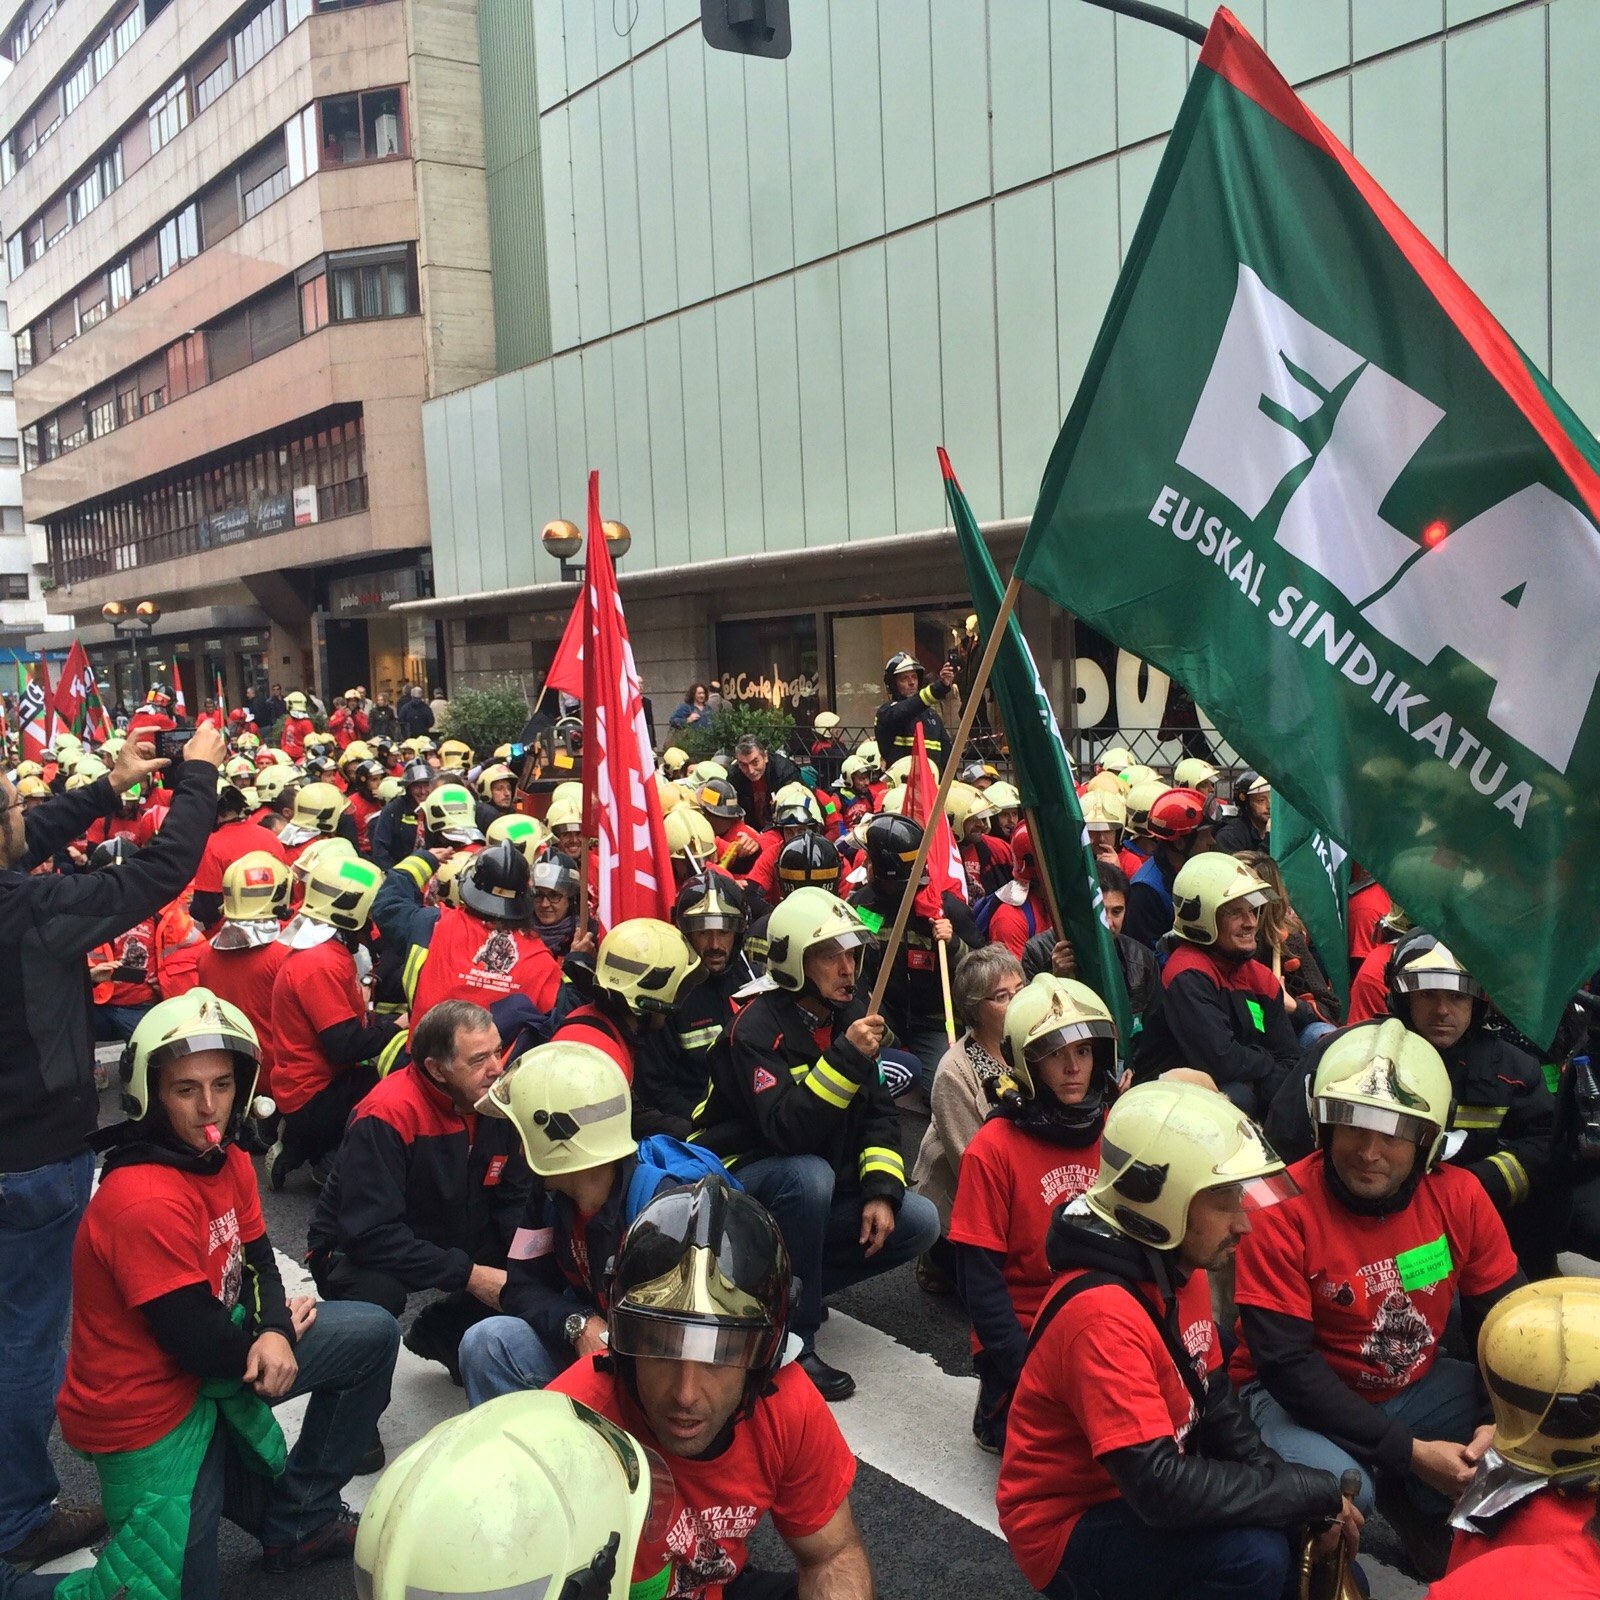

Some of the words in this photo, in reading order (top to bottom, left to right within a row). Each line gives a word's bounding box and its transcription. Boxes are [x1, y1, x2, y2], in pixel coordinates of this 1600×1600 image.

[1175, 261, 1600, 775] ELA
[340, 593, 359, 611] pablo
[381, 591, 400, 602] shoes
[1147, 484, 1269, 605] EUSKAL
[1269, 585, 1537, 830] SINDIKATUA
[722, 672, 737, 700] El
[1040, 1164, 1099, 1188] SUHILTZAIL
